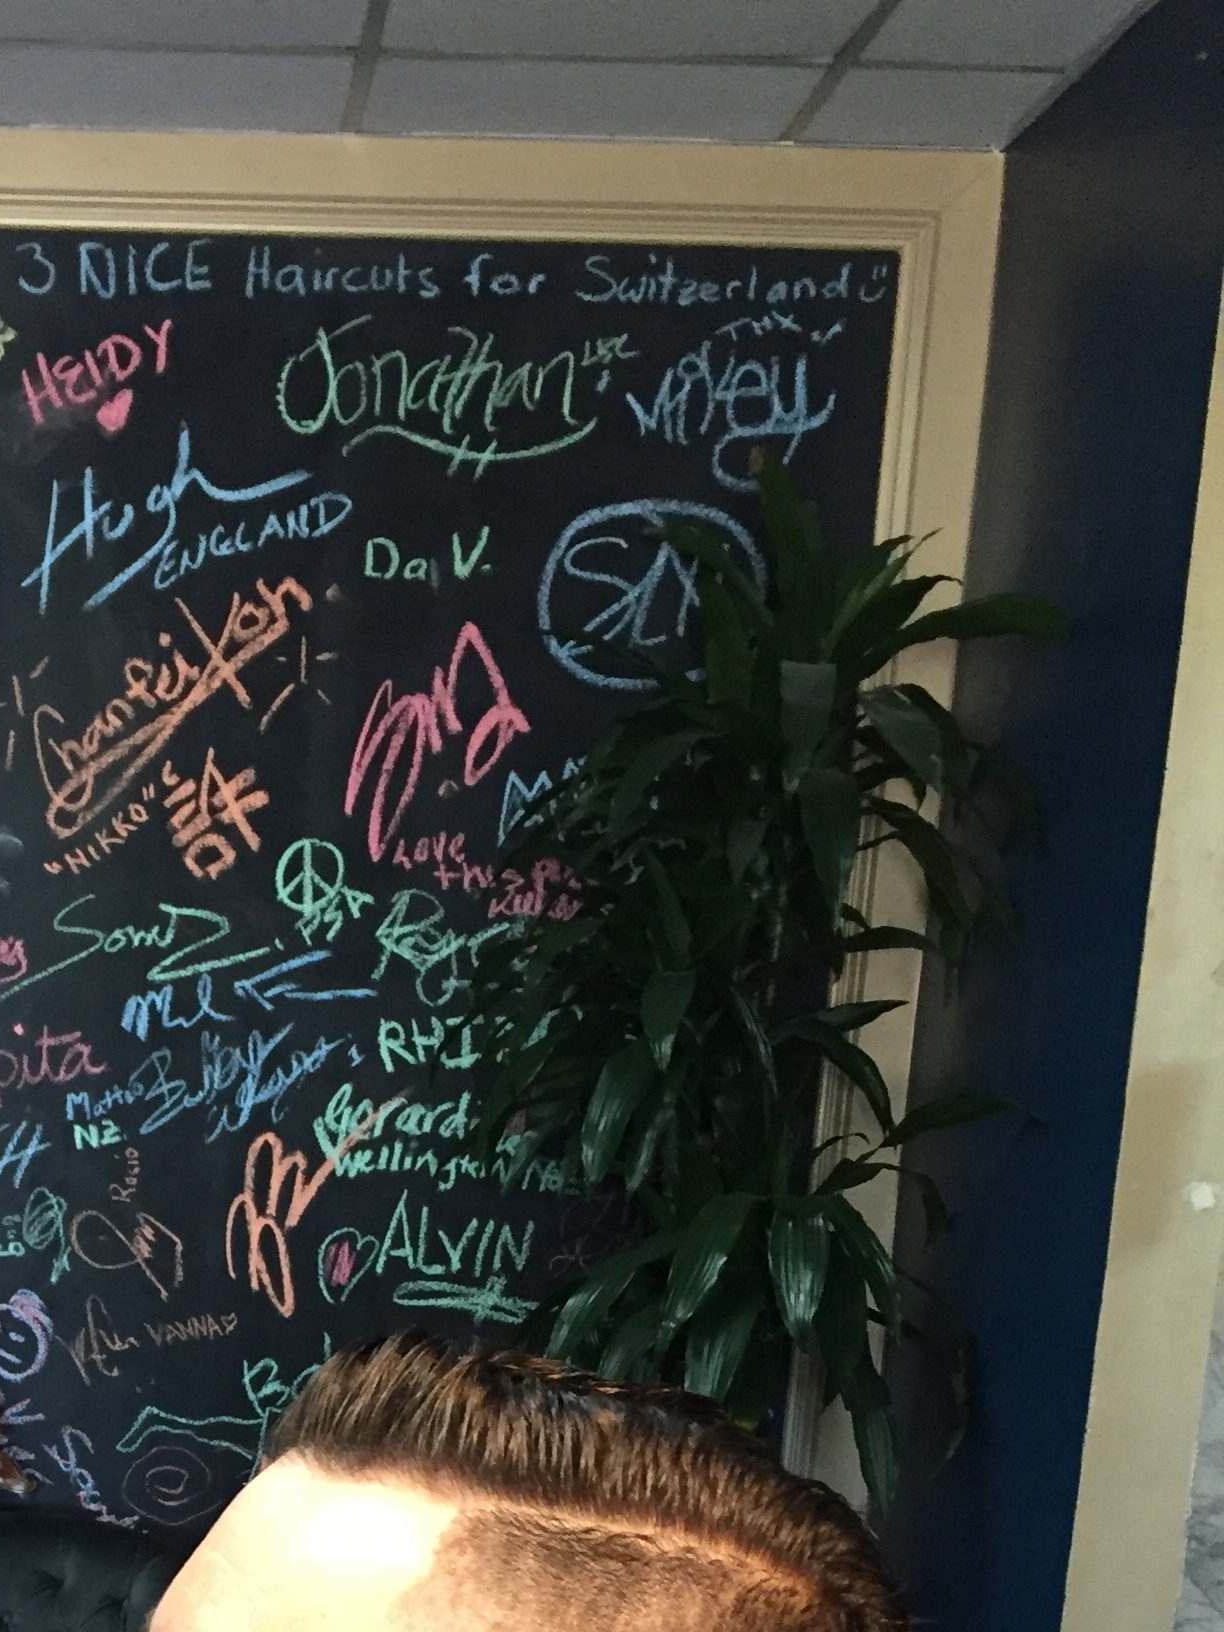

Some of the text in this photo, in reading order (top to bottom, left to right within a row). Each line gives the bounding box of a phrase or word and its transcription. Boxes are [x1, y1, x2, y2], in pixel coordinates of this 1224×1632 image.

[15, 239, 849, 306] 3 NICE Haircuts for Switzerland
[21, 317, 173, 424] HEIDY
[154, 491, 353, 590] ENGLAND
[376, 1189, 536, 1278] ALVIN
